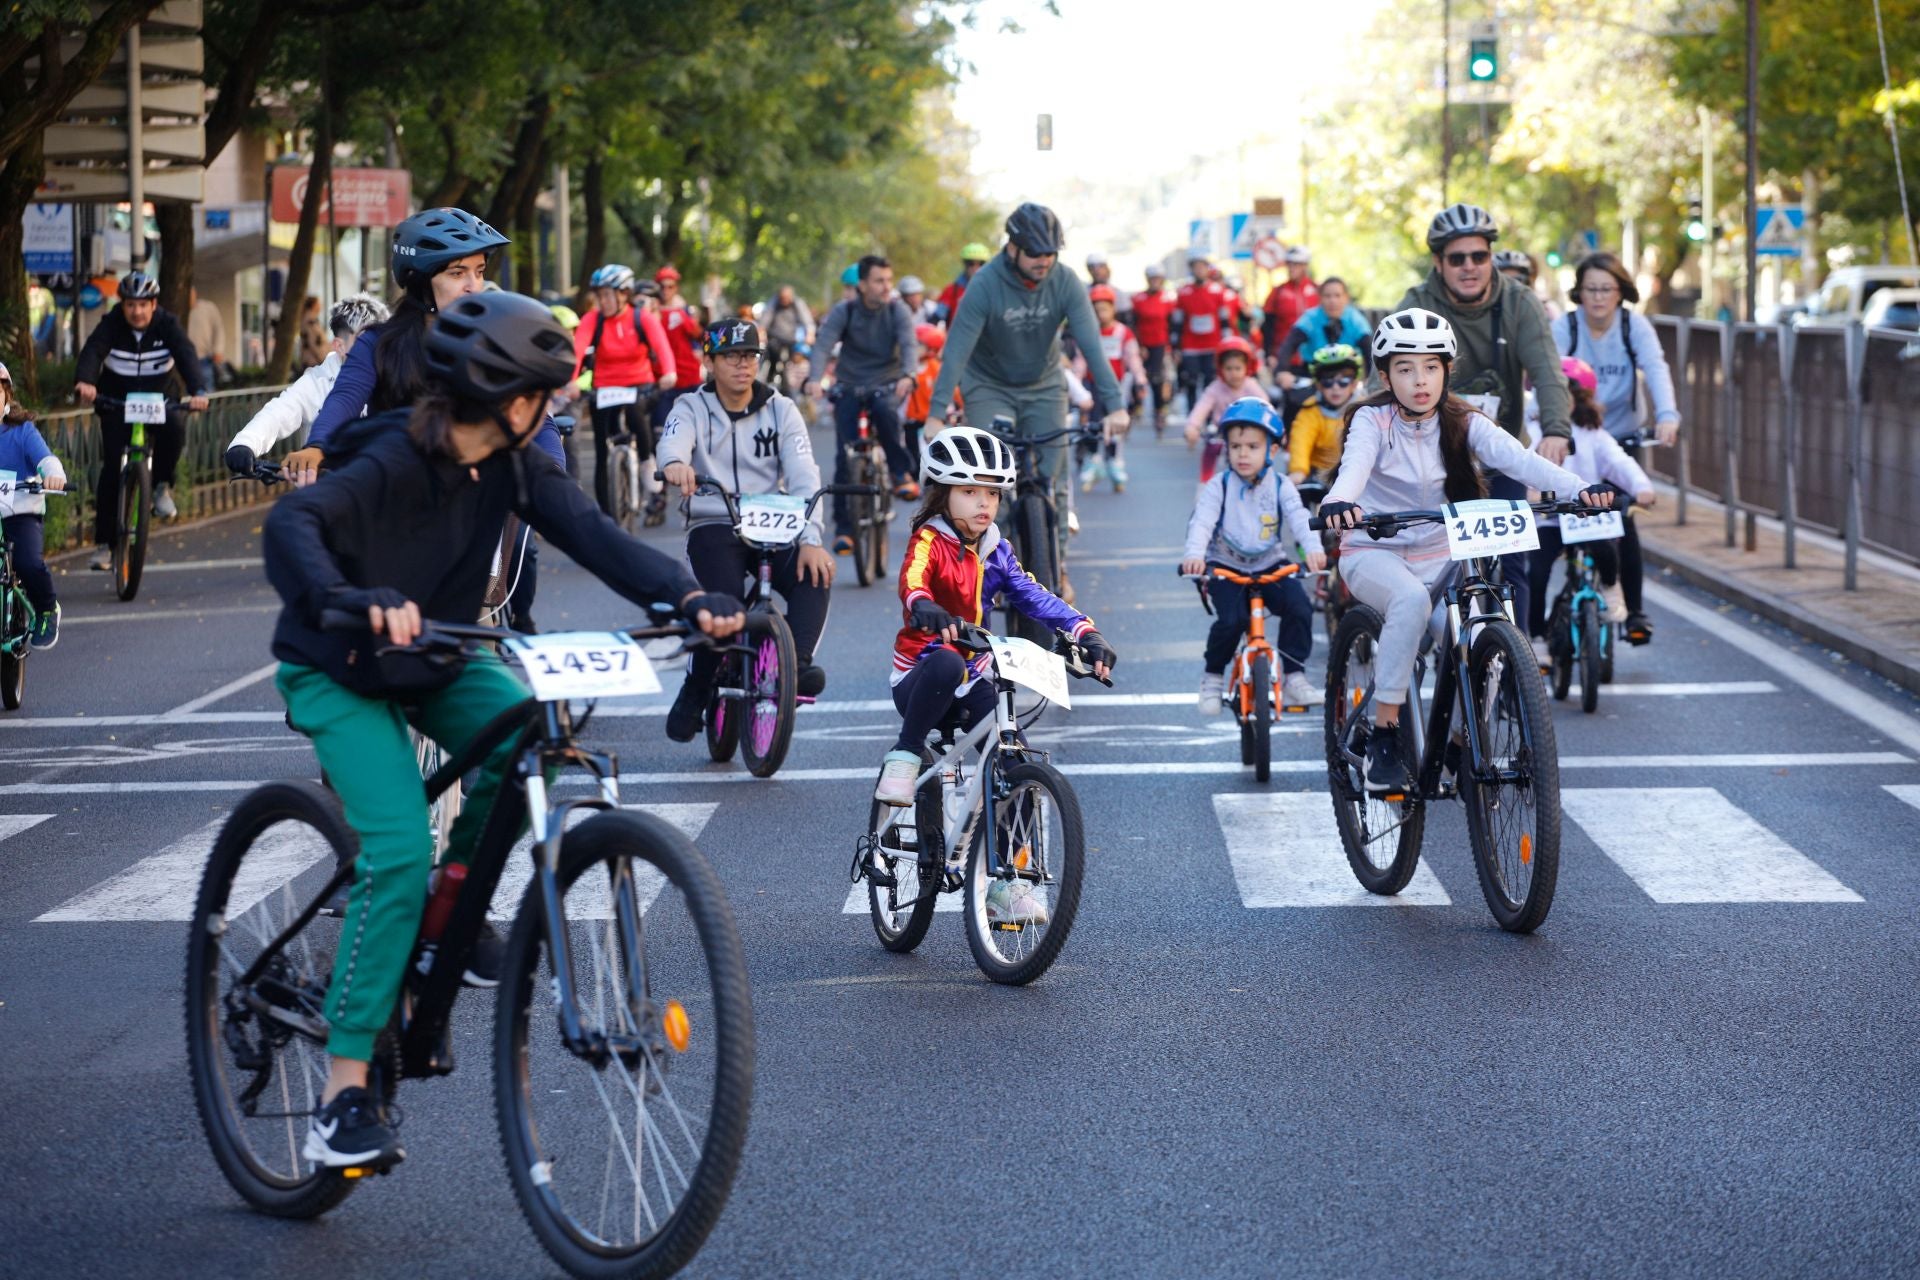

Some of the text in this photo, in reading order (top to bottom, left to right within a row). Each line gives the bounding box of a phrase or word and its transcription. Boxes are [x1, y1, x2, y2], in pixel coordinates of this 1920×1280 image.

[747, 511, 798, 529] 1272
[1455, 513, 1527, 542] 1459
[535, 650, 629, 674] 1457
